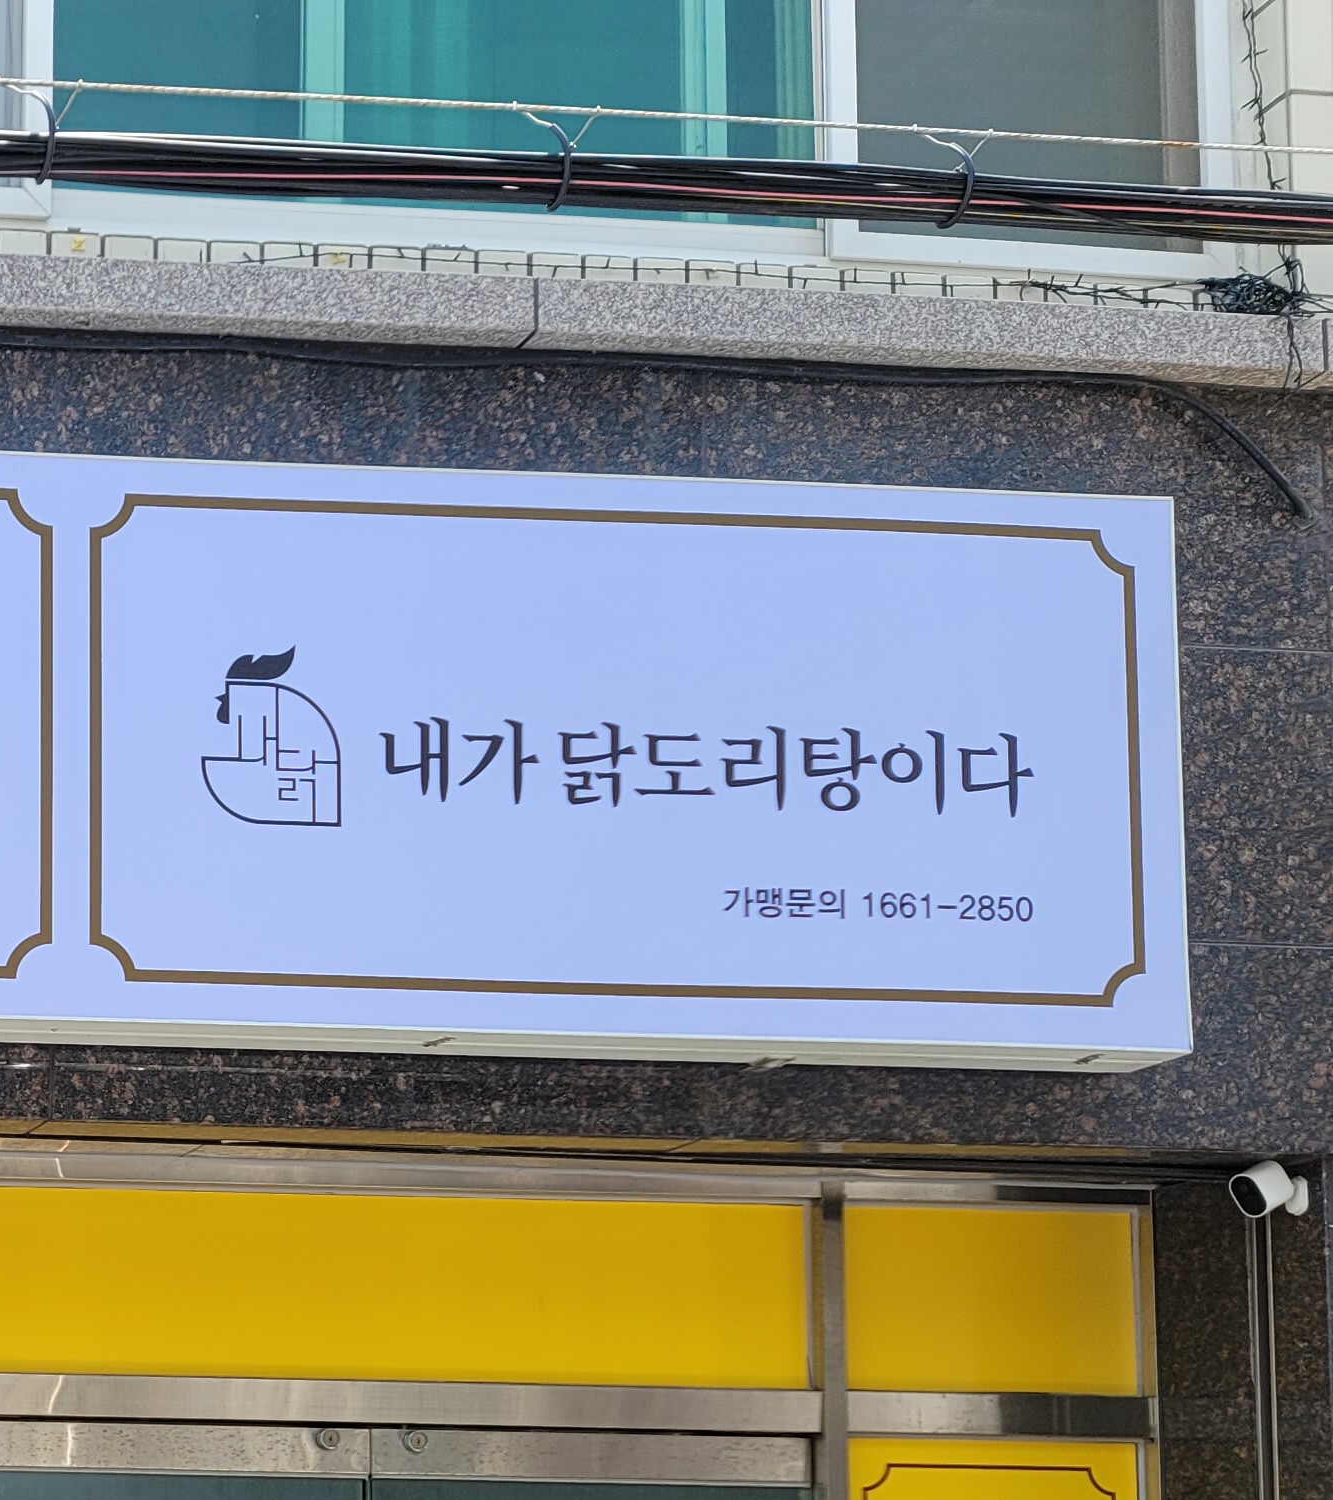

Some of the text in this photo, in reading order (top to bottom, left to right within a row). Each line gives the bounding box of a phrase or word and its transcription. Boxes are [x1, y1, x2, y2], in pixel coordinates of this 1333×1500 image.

[378, 716, 1034, 818] 내가 닭도리탕이다
[723, 886, 1034, 923] 가맹문의 1661-2850
